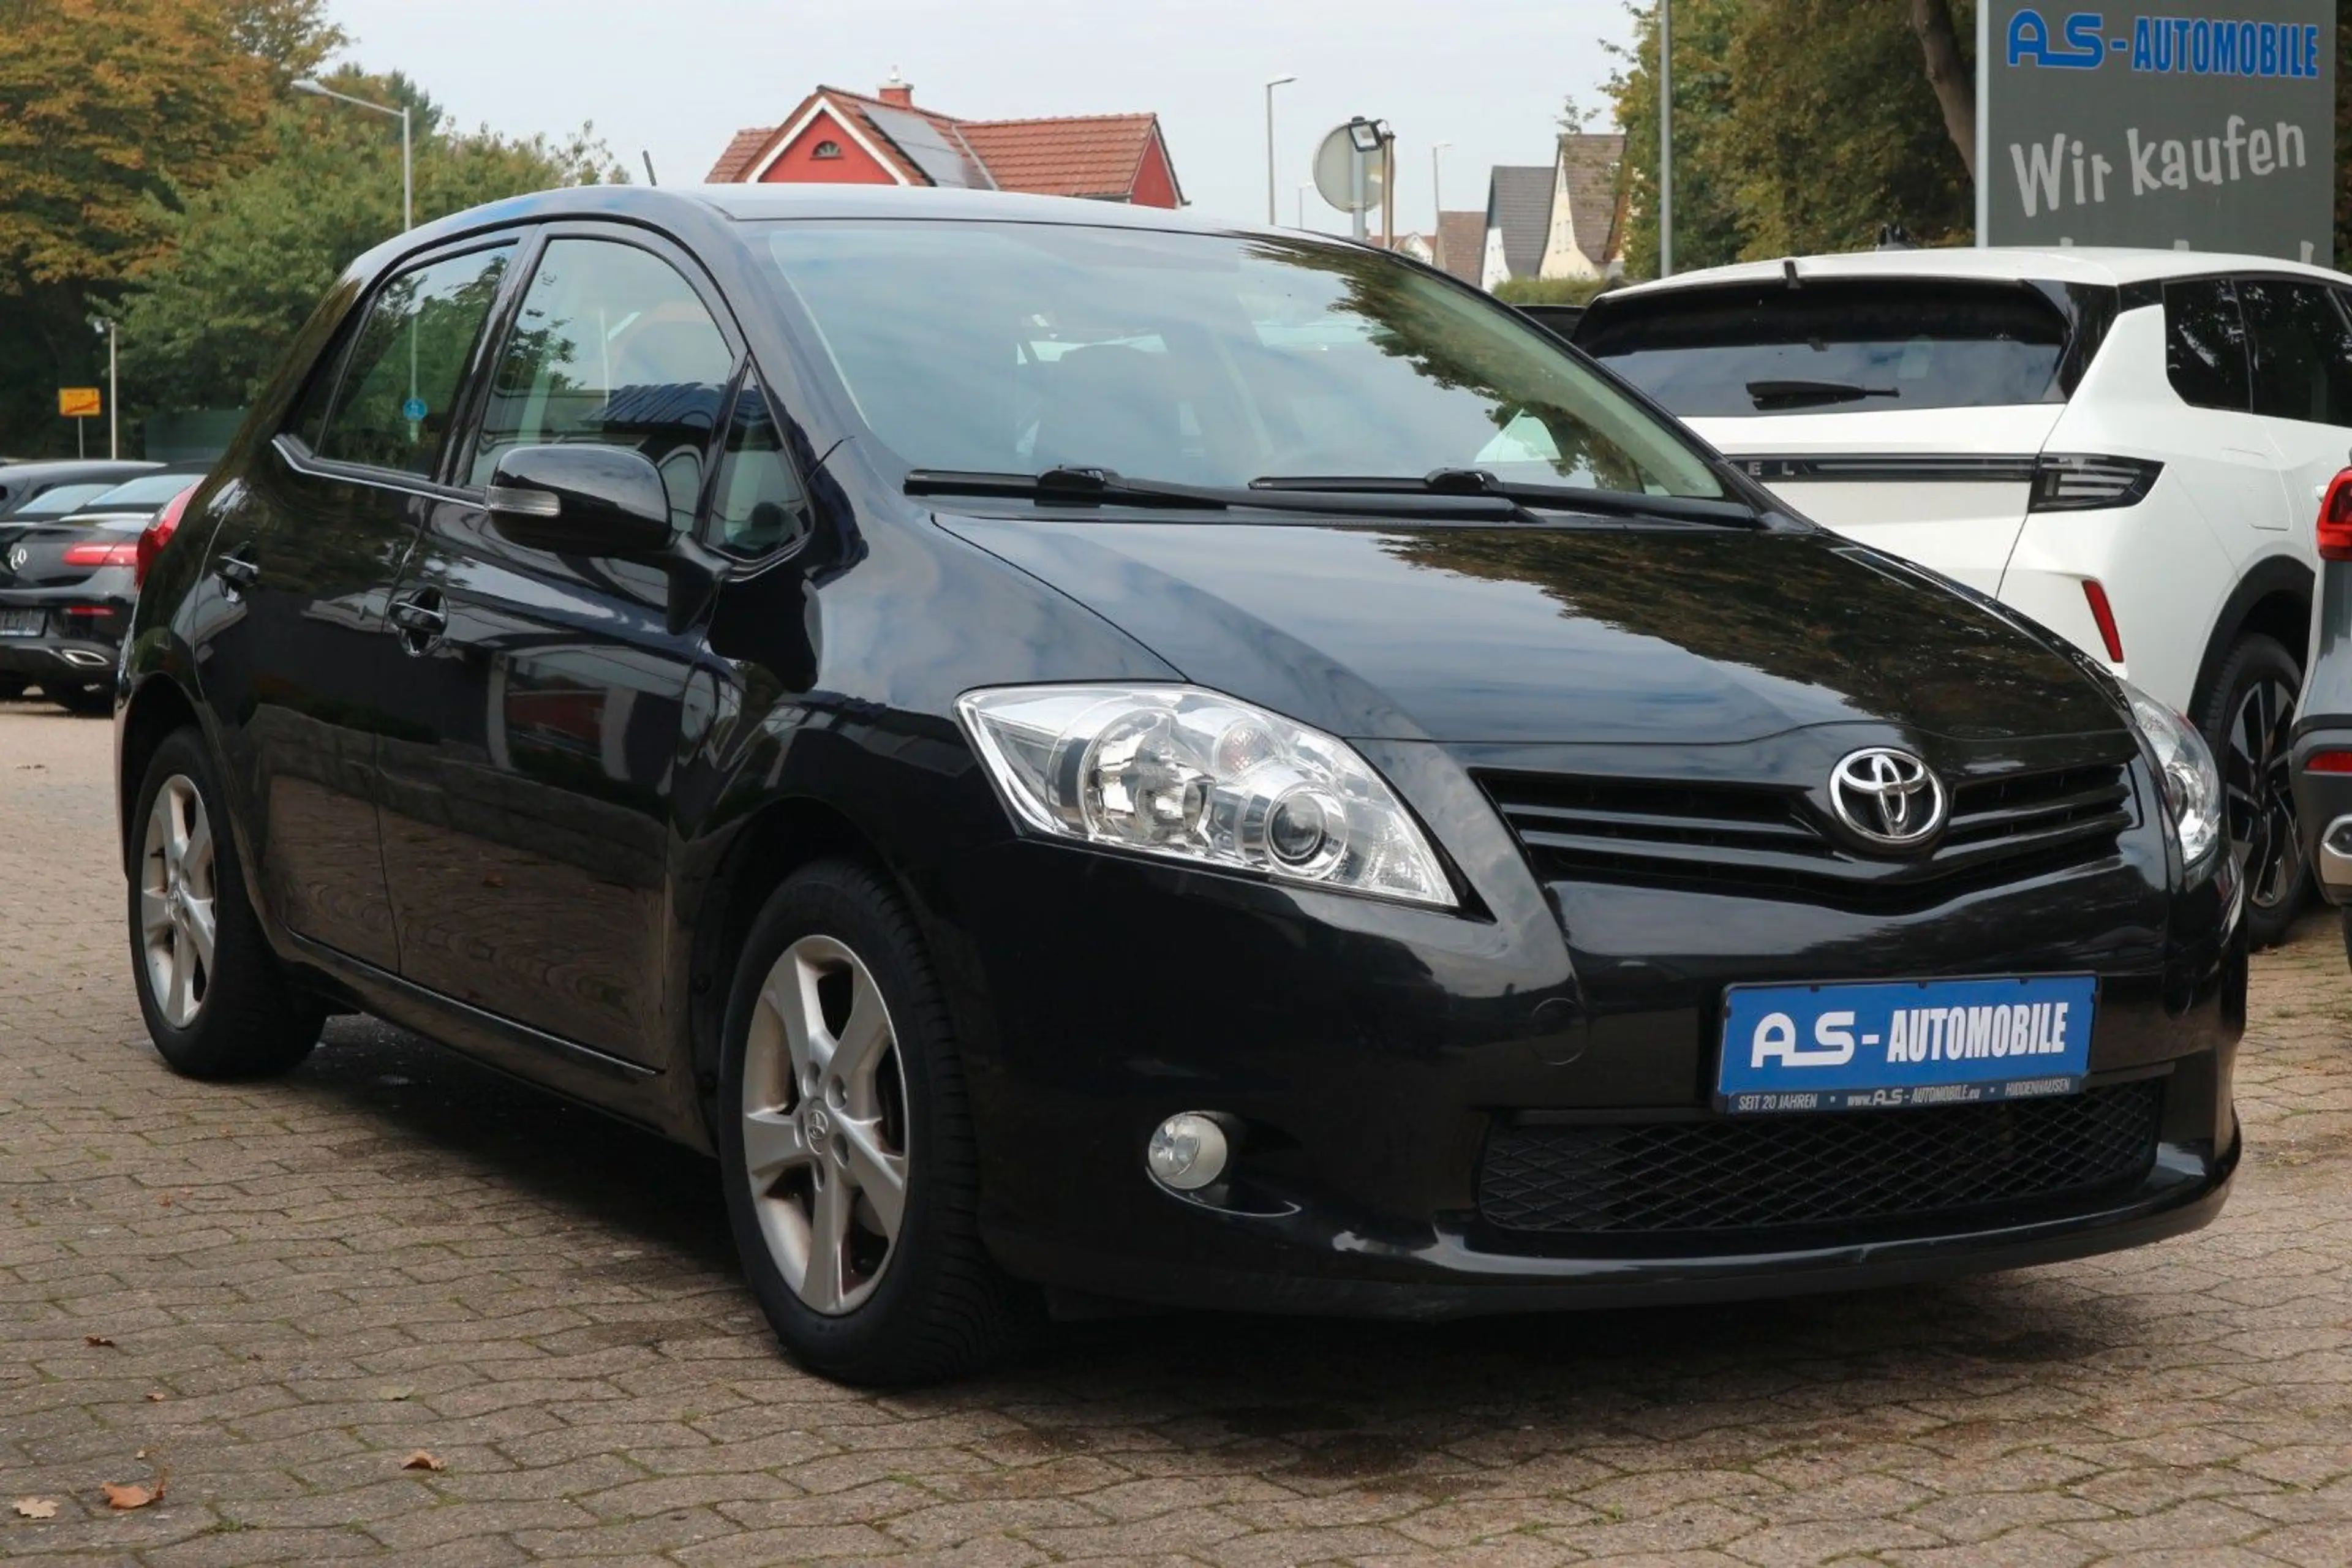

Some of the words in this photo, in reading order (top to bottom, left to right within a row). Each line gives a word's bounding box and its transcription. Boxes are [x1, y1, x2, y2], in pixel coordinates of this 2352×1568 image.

[2010, 133, 2113, 218] Wir
[2126, 114, 2307, 196] kaufen
[1738, 1095, 1761, 1110] SEIT
[1762, 1095, 1777, 1109] 20
[1777, 1093, 1819, 1109] JAHREN
